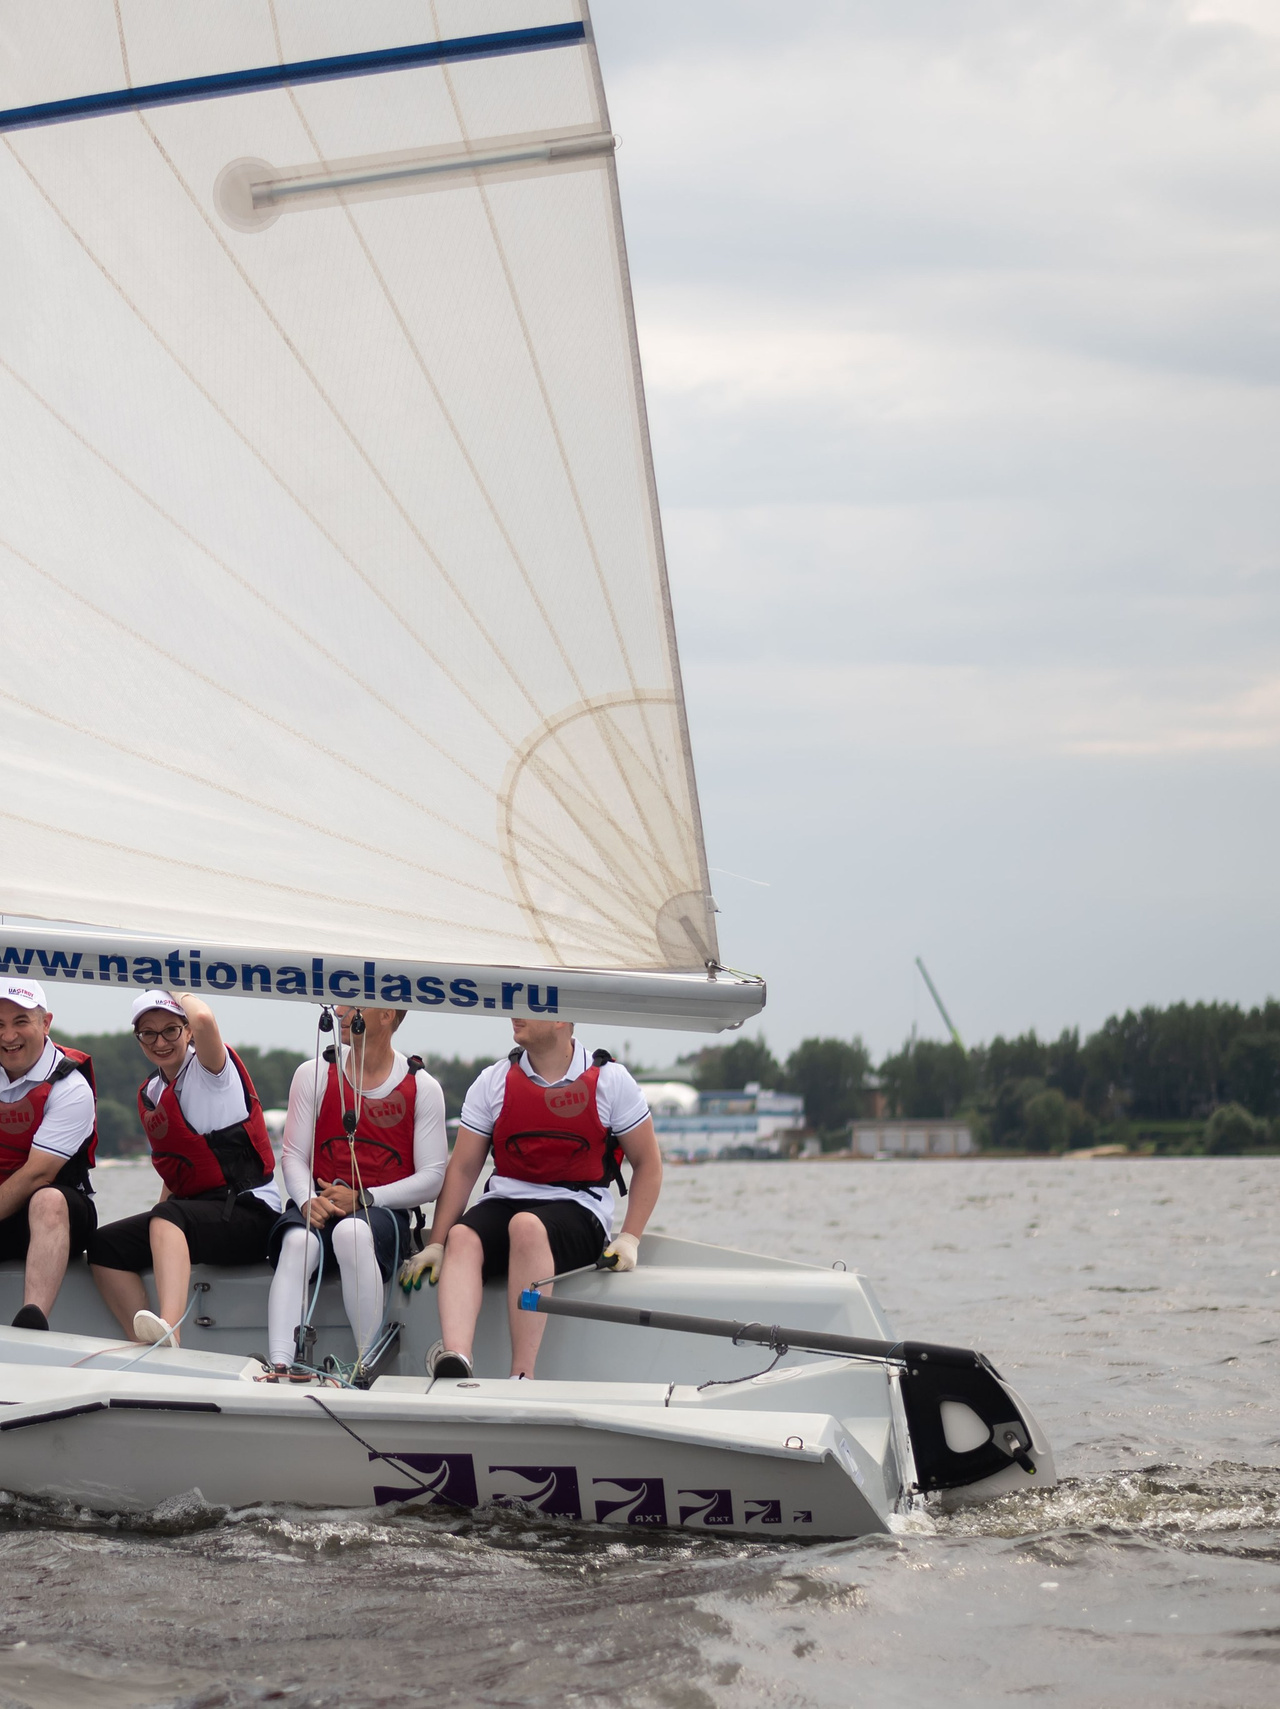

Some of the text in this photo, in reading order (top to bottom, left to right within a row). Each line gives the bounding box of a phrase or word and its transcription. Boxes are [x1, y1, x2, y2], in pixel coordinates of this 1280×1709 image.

[549, 1091, 586, 1108] Gill
[368, 1102, 403, 1118] Gill
[147, 1111, 166, 1131] Gill
[634, 1514, 662, 1522] ЯХТ
